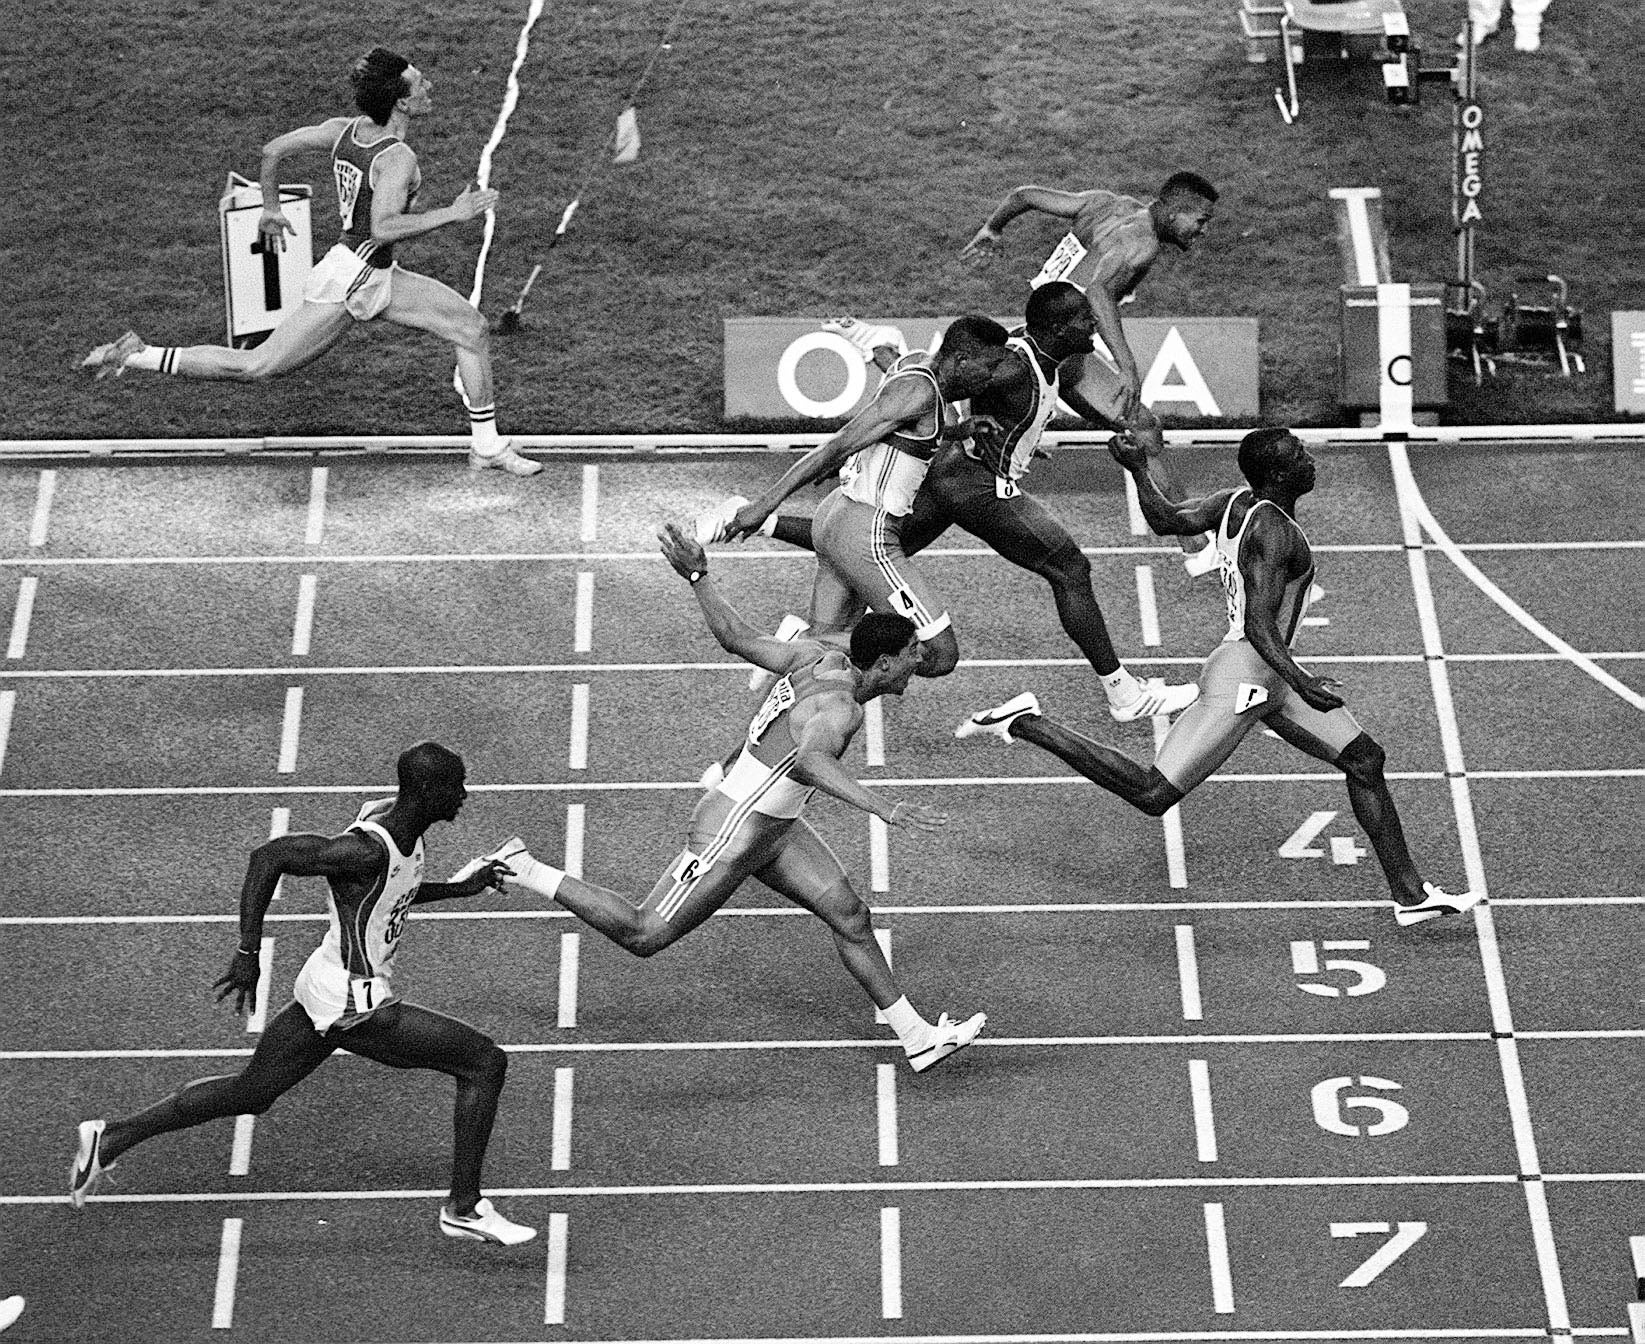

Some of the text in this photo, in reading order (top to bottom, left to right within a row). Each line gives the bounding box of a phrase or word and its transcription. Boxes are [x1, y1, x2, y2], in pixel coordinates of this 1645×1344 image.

[1462, 105, 1483, 222] OMEGA
[900, 590, 914, 610] 4
[1278, 811, 1365, 865] 4
[680, 859, 700, 882] 6
[363, 981, 374, 1010] 7
[1290, 940, 1387, 998] 5
[1311, 1075, 1410, 1138] 6
[1330, 1221, 1427, 1288] 7
